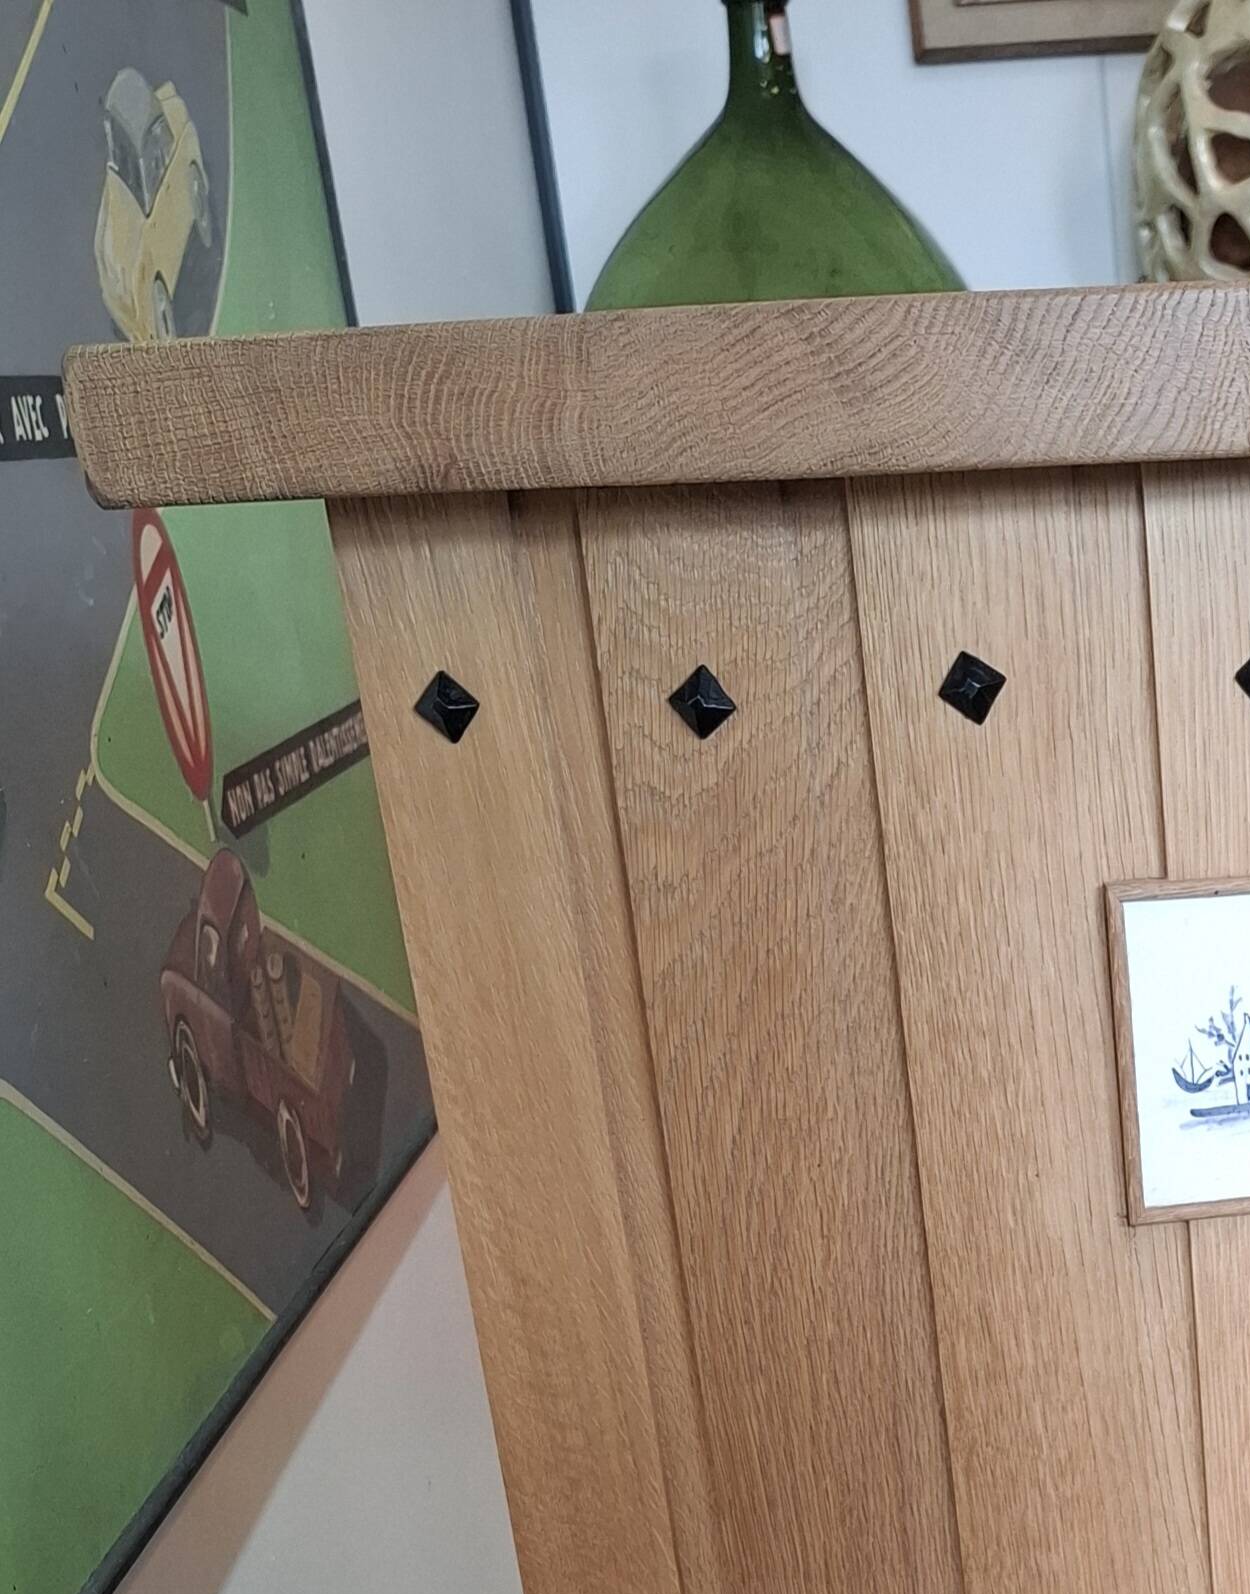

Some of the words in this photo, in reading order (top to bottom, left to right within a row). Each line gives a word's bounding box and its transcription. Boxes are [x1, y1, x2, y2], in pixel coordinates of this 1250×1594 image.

[11, 394, 49, 441] AVEC
[227, 781, 255, 827] NON
[253, 768, 275, 809] PAS
[275, 747, 310, 796] SIMPLE
